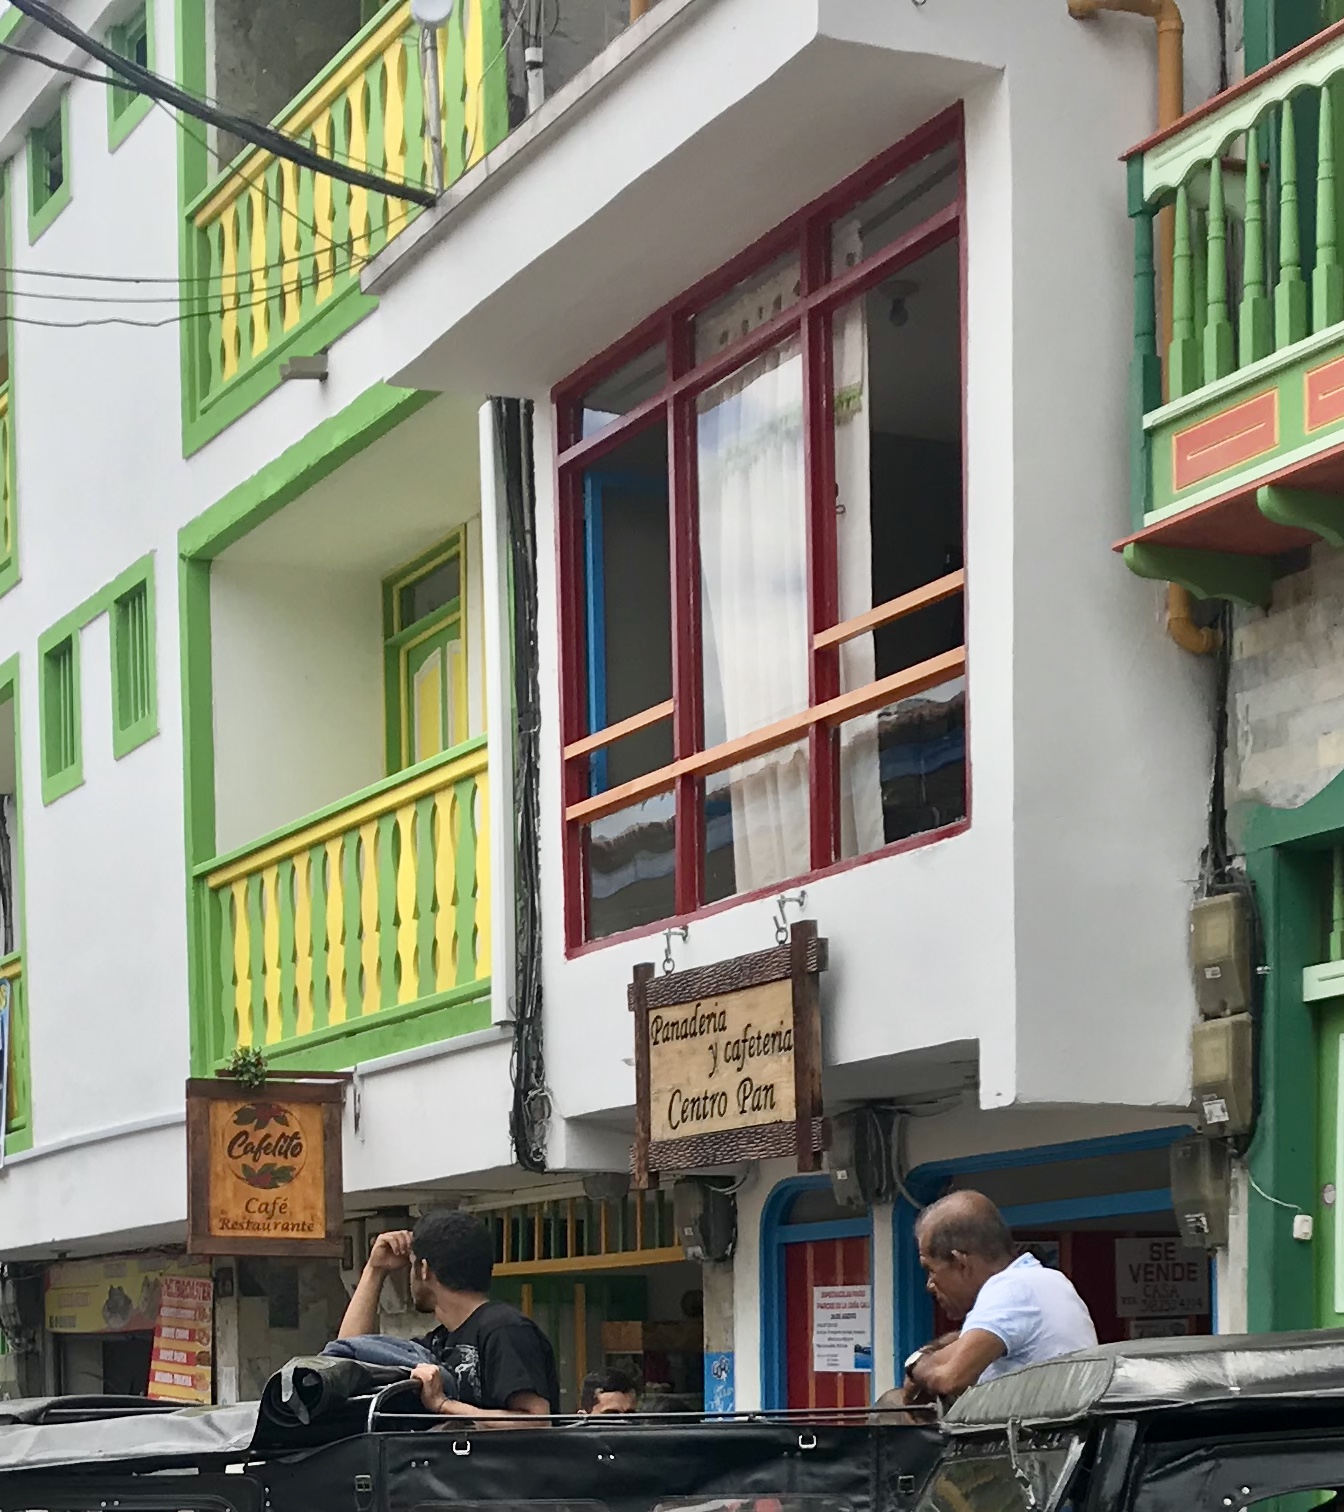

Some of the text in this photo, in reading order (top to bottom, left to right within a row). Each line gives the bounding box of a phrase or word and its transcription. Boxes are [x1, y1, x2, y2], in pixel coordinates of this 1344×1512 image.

[651, 1002, 727, 1046] Panaderia
[708, 1020, 793, 1078] y cafeteria
[668, 1076, 776, 1130] Centro Pan
[227, 1130, 303, 1162] Cafelito
[245, 1197, 288, 1220] Café
[1150, 1242, 1176, 1261] SE
[1129, 1263, 1198, 1283] VENDE
[1143, 1283, 1180, 1298] CASA
